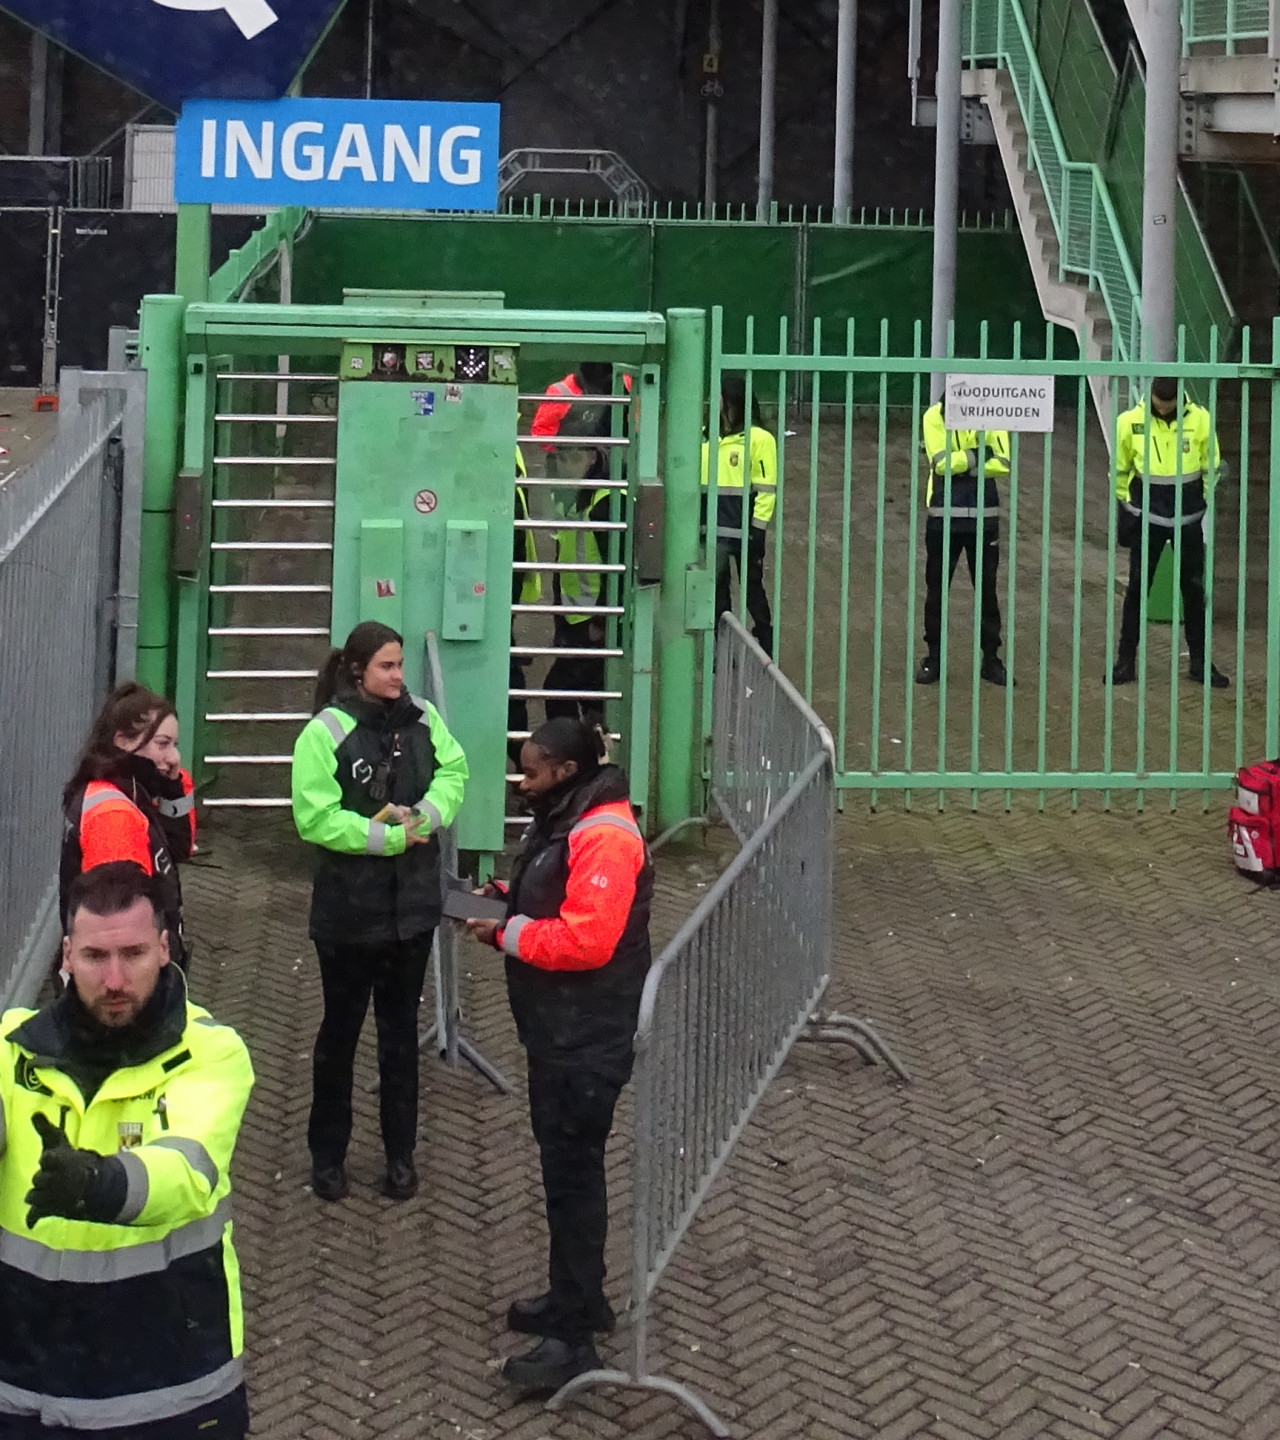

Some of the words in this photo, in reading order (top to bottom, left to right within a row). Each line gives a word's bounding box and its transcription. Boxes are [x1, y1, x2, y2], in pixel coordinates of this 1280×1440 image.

[201, 119, 482, 186] INGANG
[953, 387, 1046, 399] NOODUITGANG
[960, 406, 1040, 417] VRIJHOUDEN
[590, 874, 608, 888] 40
